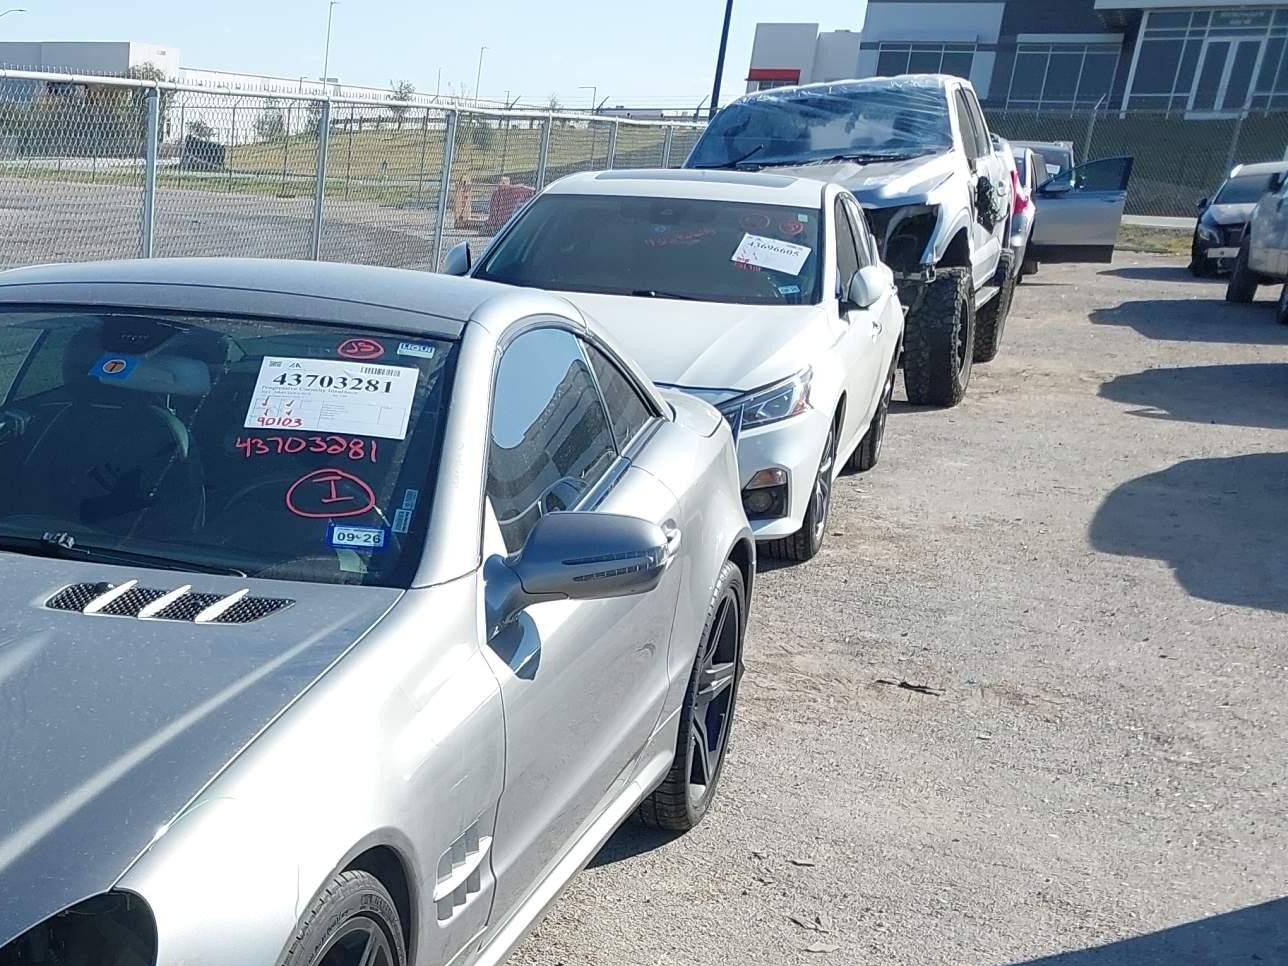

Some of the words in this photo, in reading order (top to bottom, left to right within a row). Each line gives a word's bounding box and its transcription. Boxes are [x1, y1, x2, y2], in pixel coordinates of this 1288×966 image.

[273, 372, 393, 394] 43703281
[257, 417, 303, 428] 90103
[235, 436, 378, 463] 43703281
[337, 532, 355, 542] 09
[363, 533, 381, 544] 26
